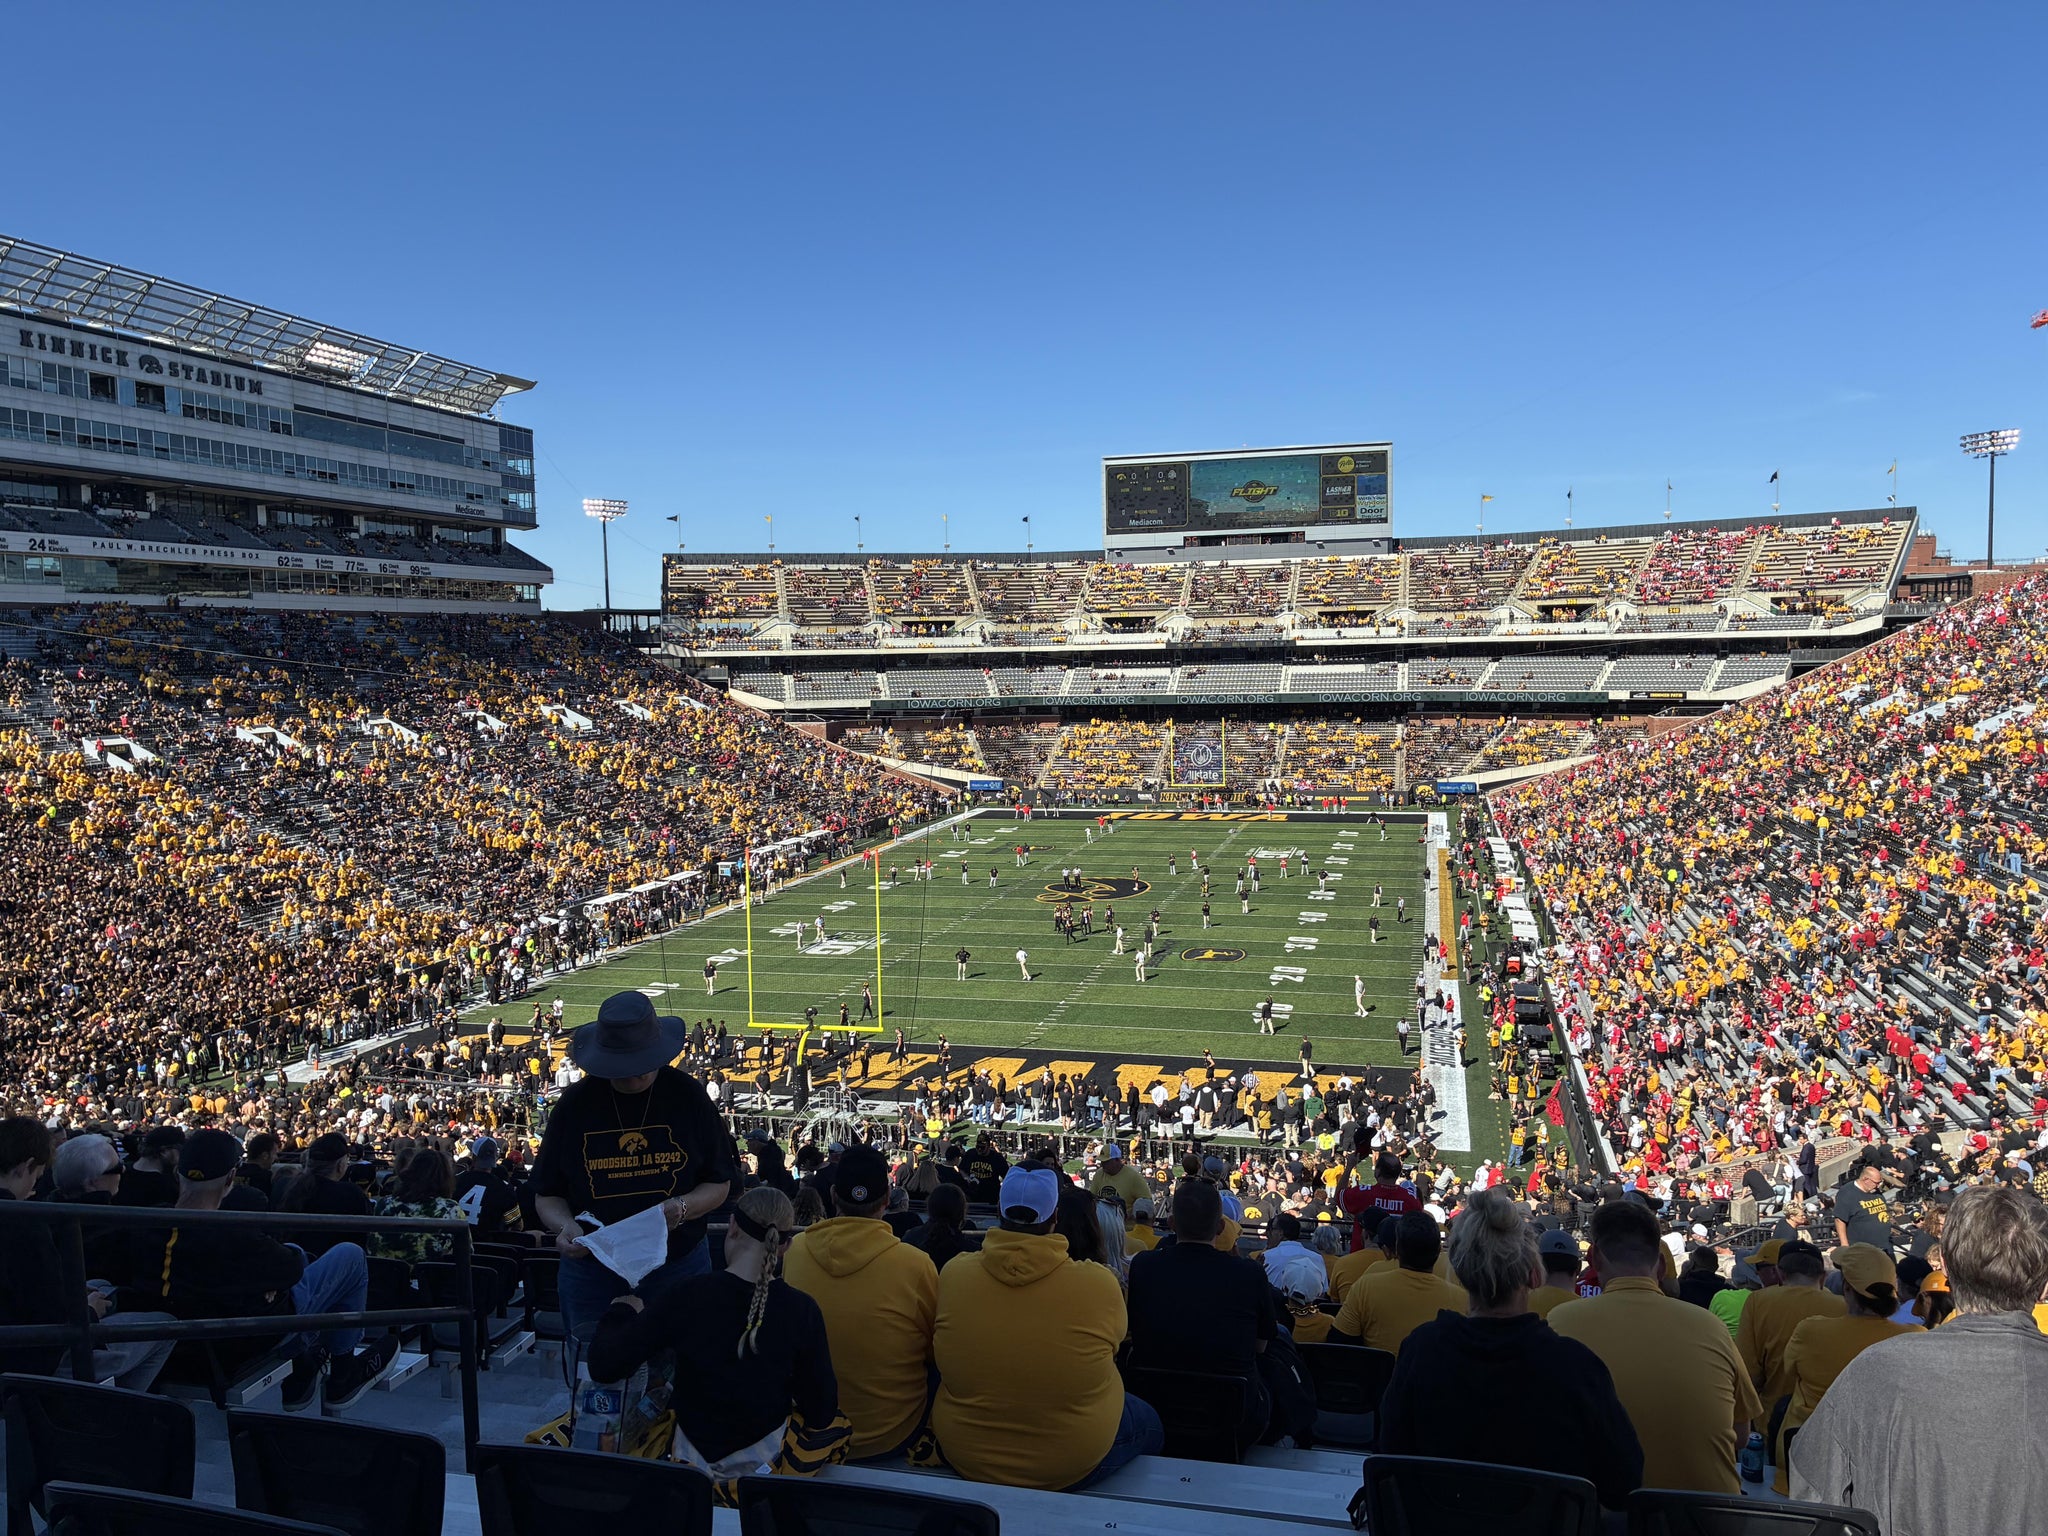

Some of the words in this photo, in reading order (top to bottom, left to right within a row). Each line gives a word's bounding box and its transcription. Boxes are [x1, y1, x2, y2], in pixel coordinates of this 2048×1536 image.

[20, 329, 129, 368] KINNICK
[169, 361, 263, 396] STADIUM
[1231, 486, 1278, 496] FLIGHT
[456, 504, 486, 517] Mediacom
[28, 538, 46, 552] 24
[92, 541, 121, 550] PAUL
[126, 544, 136, 552] W.
[140, 545, 196, 555] BRECHLER
[204, 549, 234, 558] PRESS
[278, 556, 290, 566] 62
[316, 558, 320, 569] 1
[345, 560, 356, 570] 77
[379, 563, 388, 573] 16
[410, 565, 420, 575] 99
[1042, 696, 1135, 705] IOWACORN.ORG
[1177, 694, 1274, 704] IOWACORN.ORG
[1319, 693, 1422, 702] IOWACORN.ORG
[1465, 692, 1566, 702] IOWACORN.ORG
[908, 698, 1001, 709] IOWACORN.ORG
[1095, 812, 1288, 822] IOWA
[643, 1154, 653, 1165] IA
[655, 1152, 681, 1164] 52242
[970, 1161, 993, 1172] IOWA
[608, 1171, 634, 1179] KINNICK
[634, 1168, 660, 1177] STADIUM
[458, 1184, 486, 1226] 4
[1375, 1198, 1404, 1211] ELLIOTT
[262, 1376, 272, 1388] 20
